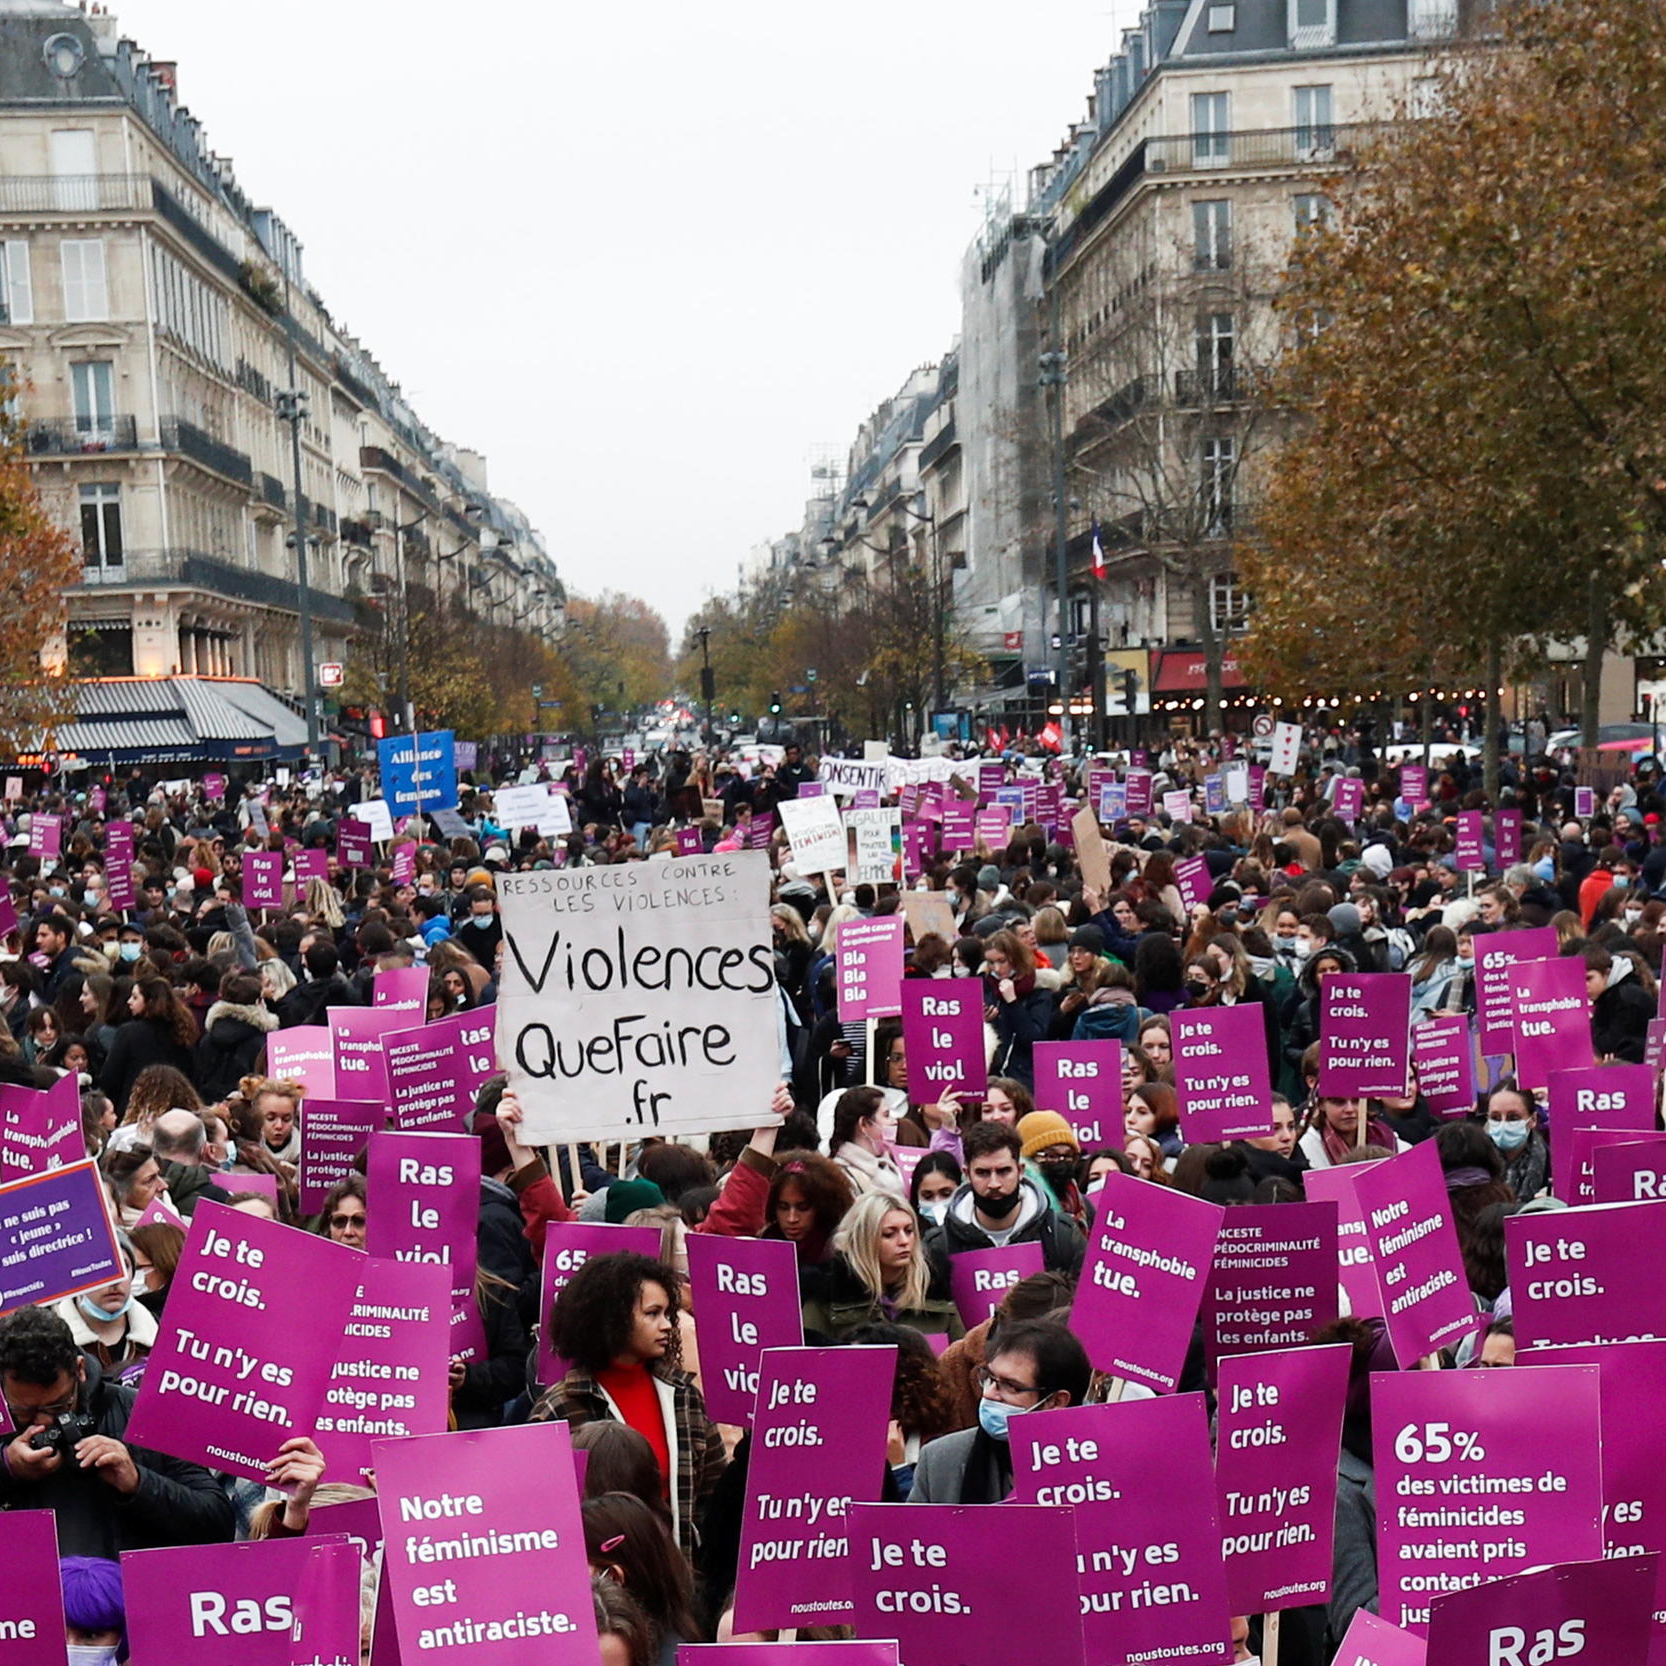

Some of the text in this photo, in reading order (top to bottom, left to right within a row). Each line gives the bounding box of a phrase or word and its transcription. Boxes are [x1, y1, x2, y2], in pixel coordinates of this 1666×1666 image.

[504, 862, 736, 896] RESSOURCES CONTRE
[554, 894, 594, 913] LES
[505, 925, 773, 995] Violences
[516, 1015, 737, 1080] QueFaire
[625, 1079, 671, 1126] .fr
[4, 1215, 19, 1228] ne
[22, 1207, 46, 1222] suis
[49, 1200, 70, 1216] pas
[19, 1222, 52, 1245] jeune
[2, 1251, 27, 1267] suis
[29, 1233, 84, 1258] directrice
[1216, 1285, 1315, 1304] La justice ne
[1216, 1308, 1312, 1325] protège pas
[1217, 1329, 1309, 1344] les enfants.
